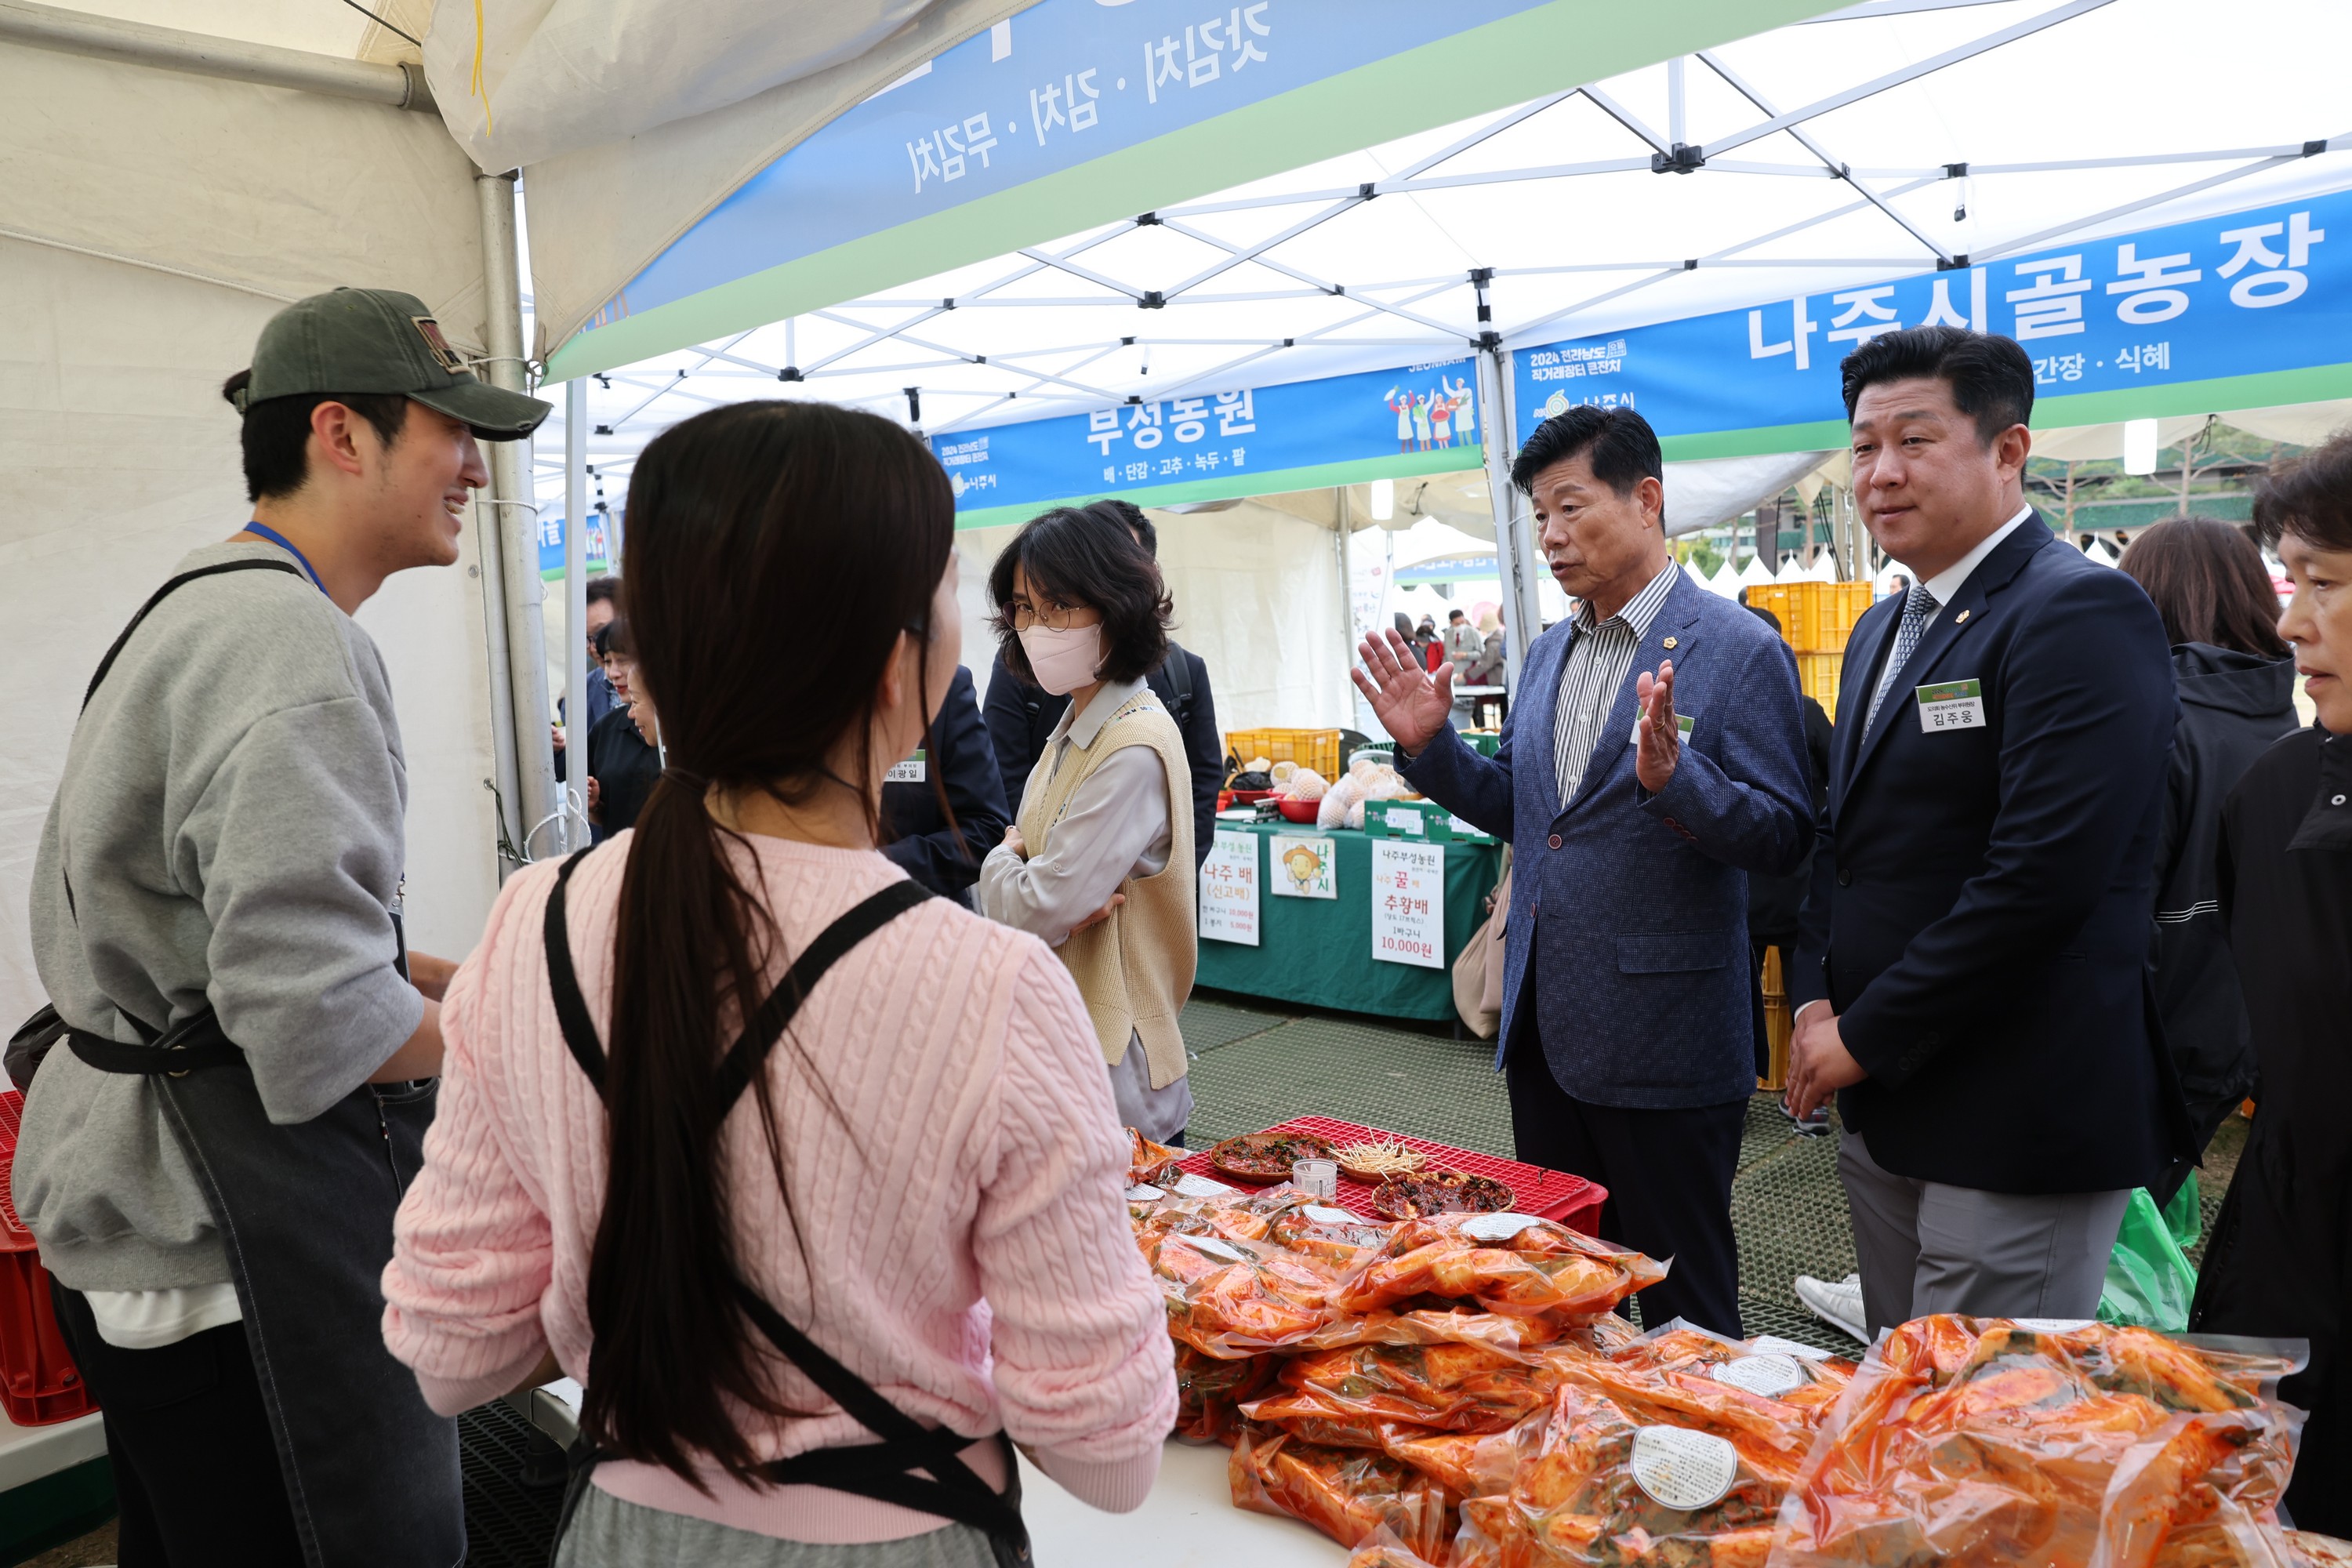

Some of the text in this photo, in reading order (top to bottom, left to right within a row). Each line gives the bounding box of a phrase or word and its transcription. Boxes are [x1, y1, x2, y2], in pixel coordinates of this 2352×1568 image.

[1530, 350, 1559, 367] 2024
[1560, 347, 1606, 363] 전라남도
[2034, 341, 2170, 385] 간장 식혜
[1531, 359, 1621, 382] 직거래장터 큰잔치
[1087, 389, 1256, 456] 부성농원
[1103, 447, 1246, 484] 배 단감 고추 녹두 팥
[970, 474, 996, 490] 나주시
[1204, 863, 1252, 884] 나주 배
[1395, 871, 1408, 889] 꿀
[1207, 883, 1250, 901] (신고배)
[1385, 895, 1428, 915] 추황배
[1382, 936, 1432, 959] 10,000원
